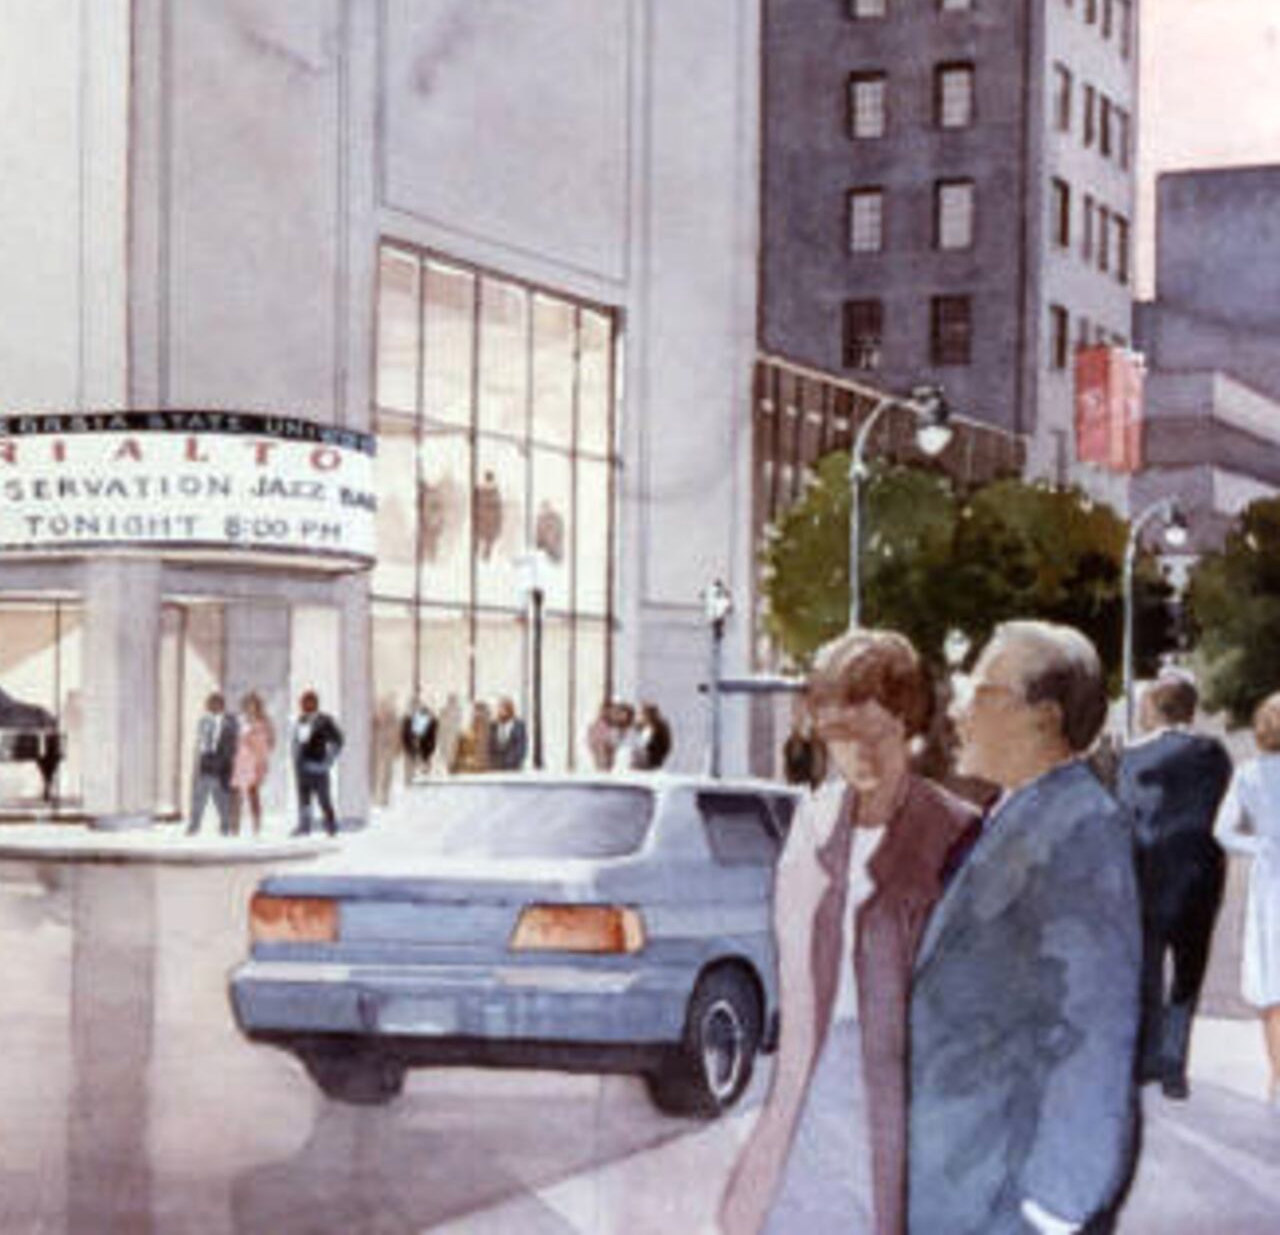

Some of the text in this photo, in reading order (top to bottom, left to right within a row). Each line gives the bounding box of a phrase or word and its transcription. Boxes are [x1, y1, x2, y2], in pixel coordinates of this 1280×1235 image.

[147, 412, 243, 433] STATE
[249, 476, 326, 501] JAZZ
[24, 514, 343, 540] TONIGHT 8:00 PM
